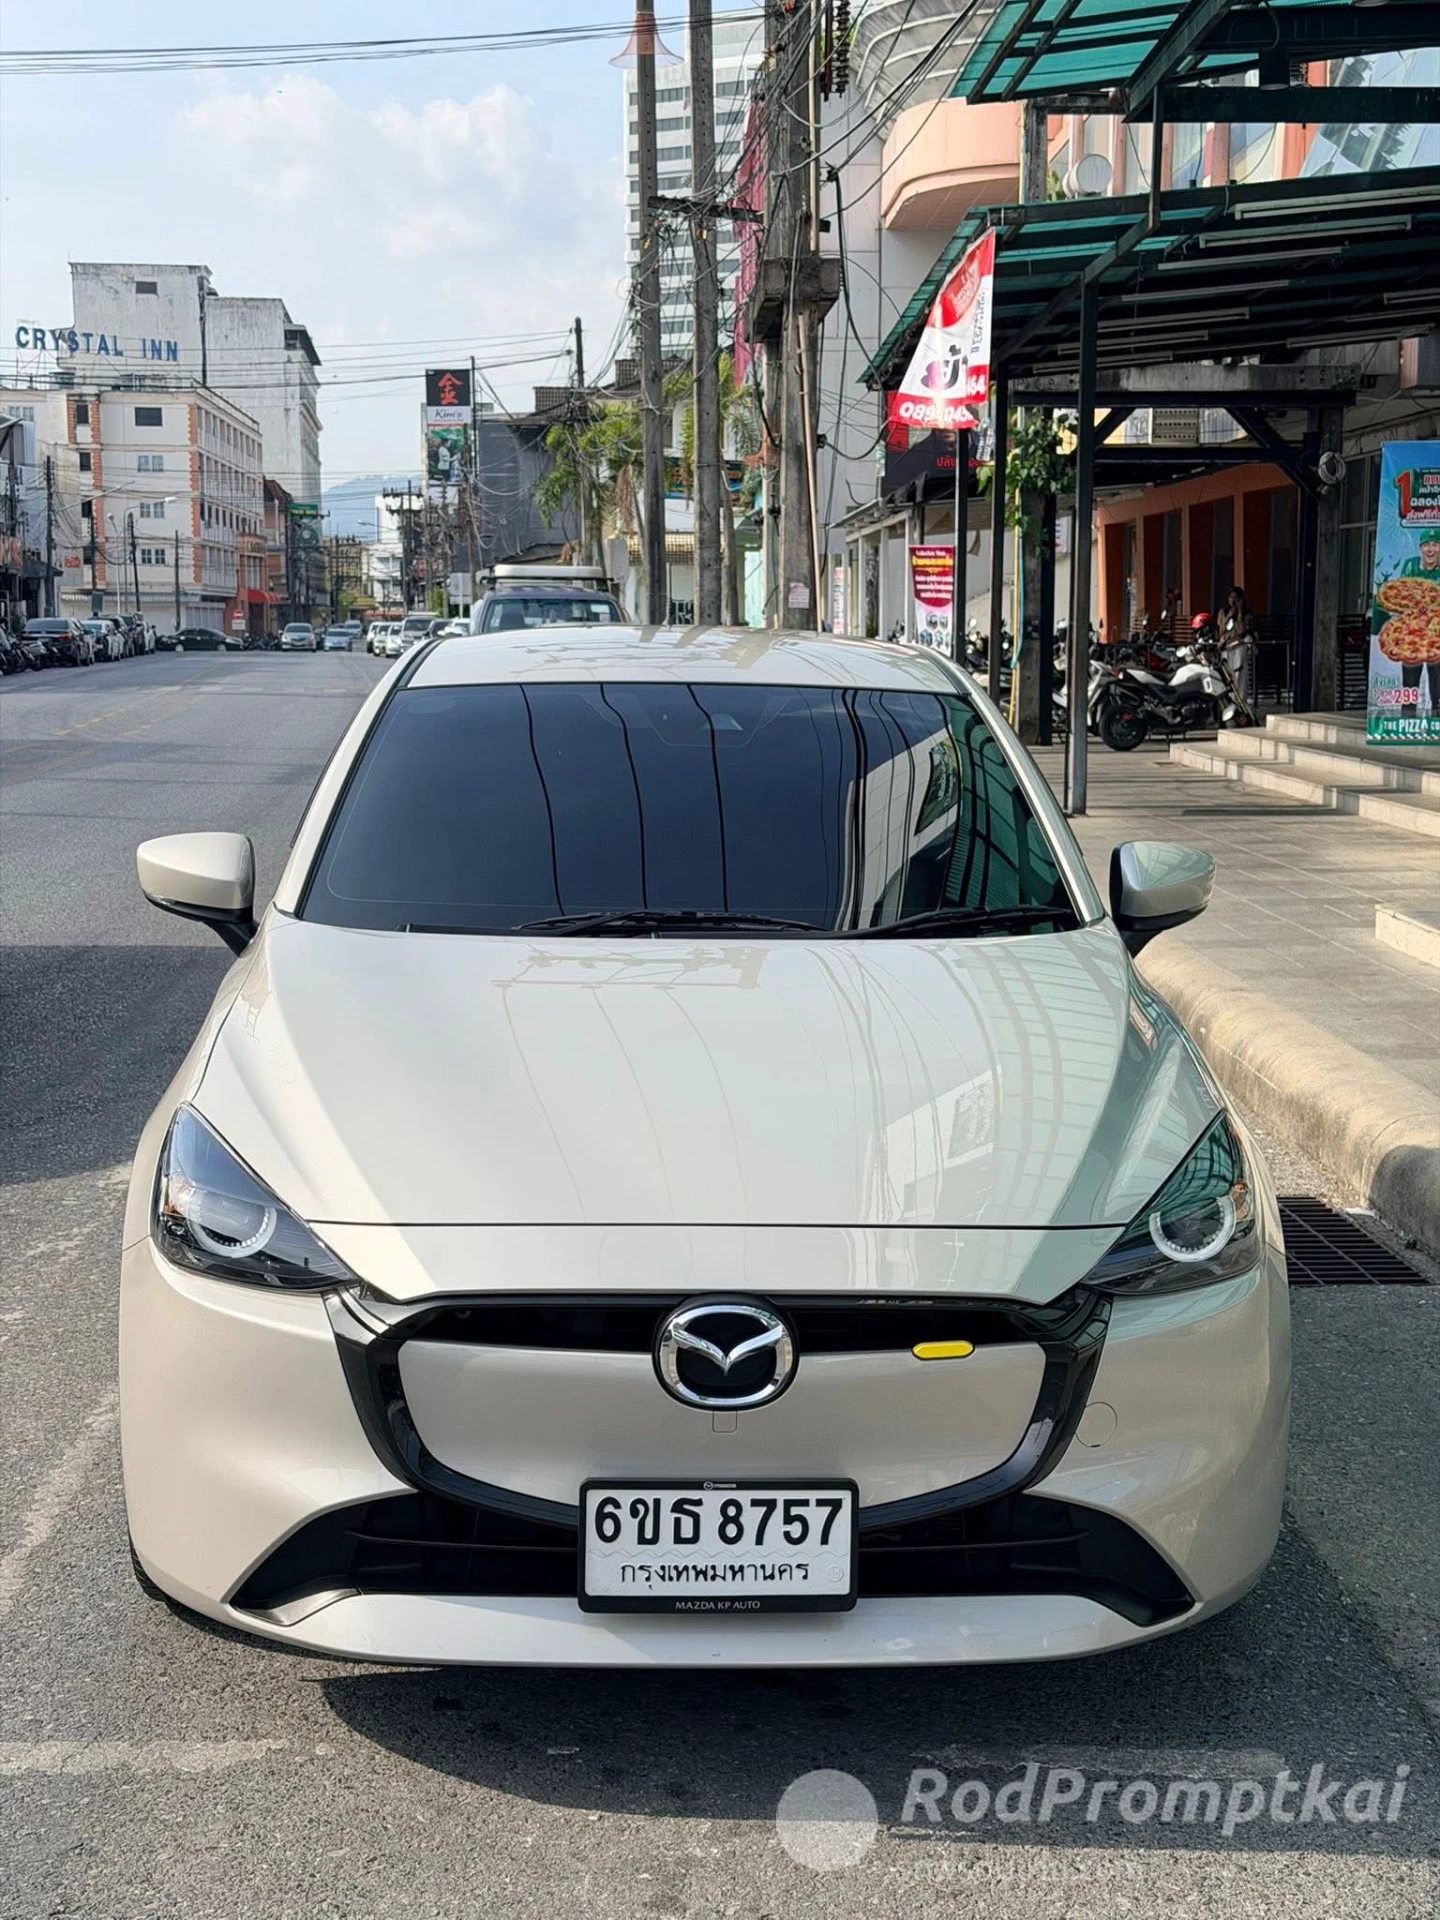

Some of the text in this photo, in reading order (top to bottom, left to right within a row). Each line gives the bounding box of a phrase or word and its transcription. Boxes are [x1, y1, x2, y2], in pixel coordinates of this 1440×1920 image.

[15, 326, 179, 361] CRYSTAL INN
[437, 372, 464, 406] 金
[1395, 470, 1411, 515] 1
[1394, 689, 1419, 704] 299
[1384, 721, 1397, 731] THE
[1398, 719, 1428, 733] PIZZA
[594, 1496, 843, 1546] 6ขธ 8757
[620, 1563, 810, 1590] กรุงเทพมหานคร
[675, 1601, 761, 1610] MAZDA KP AUTO
